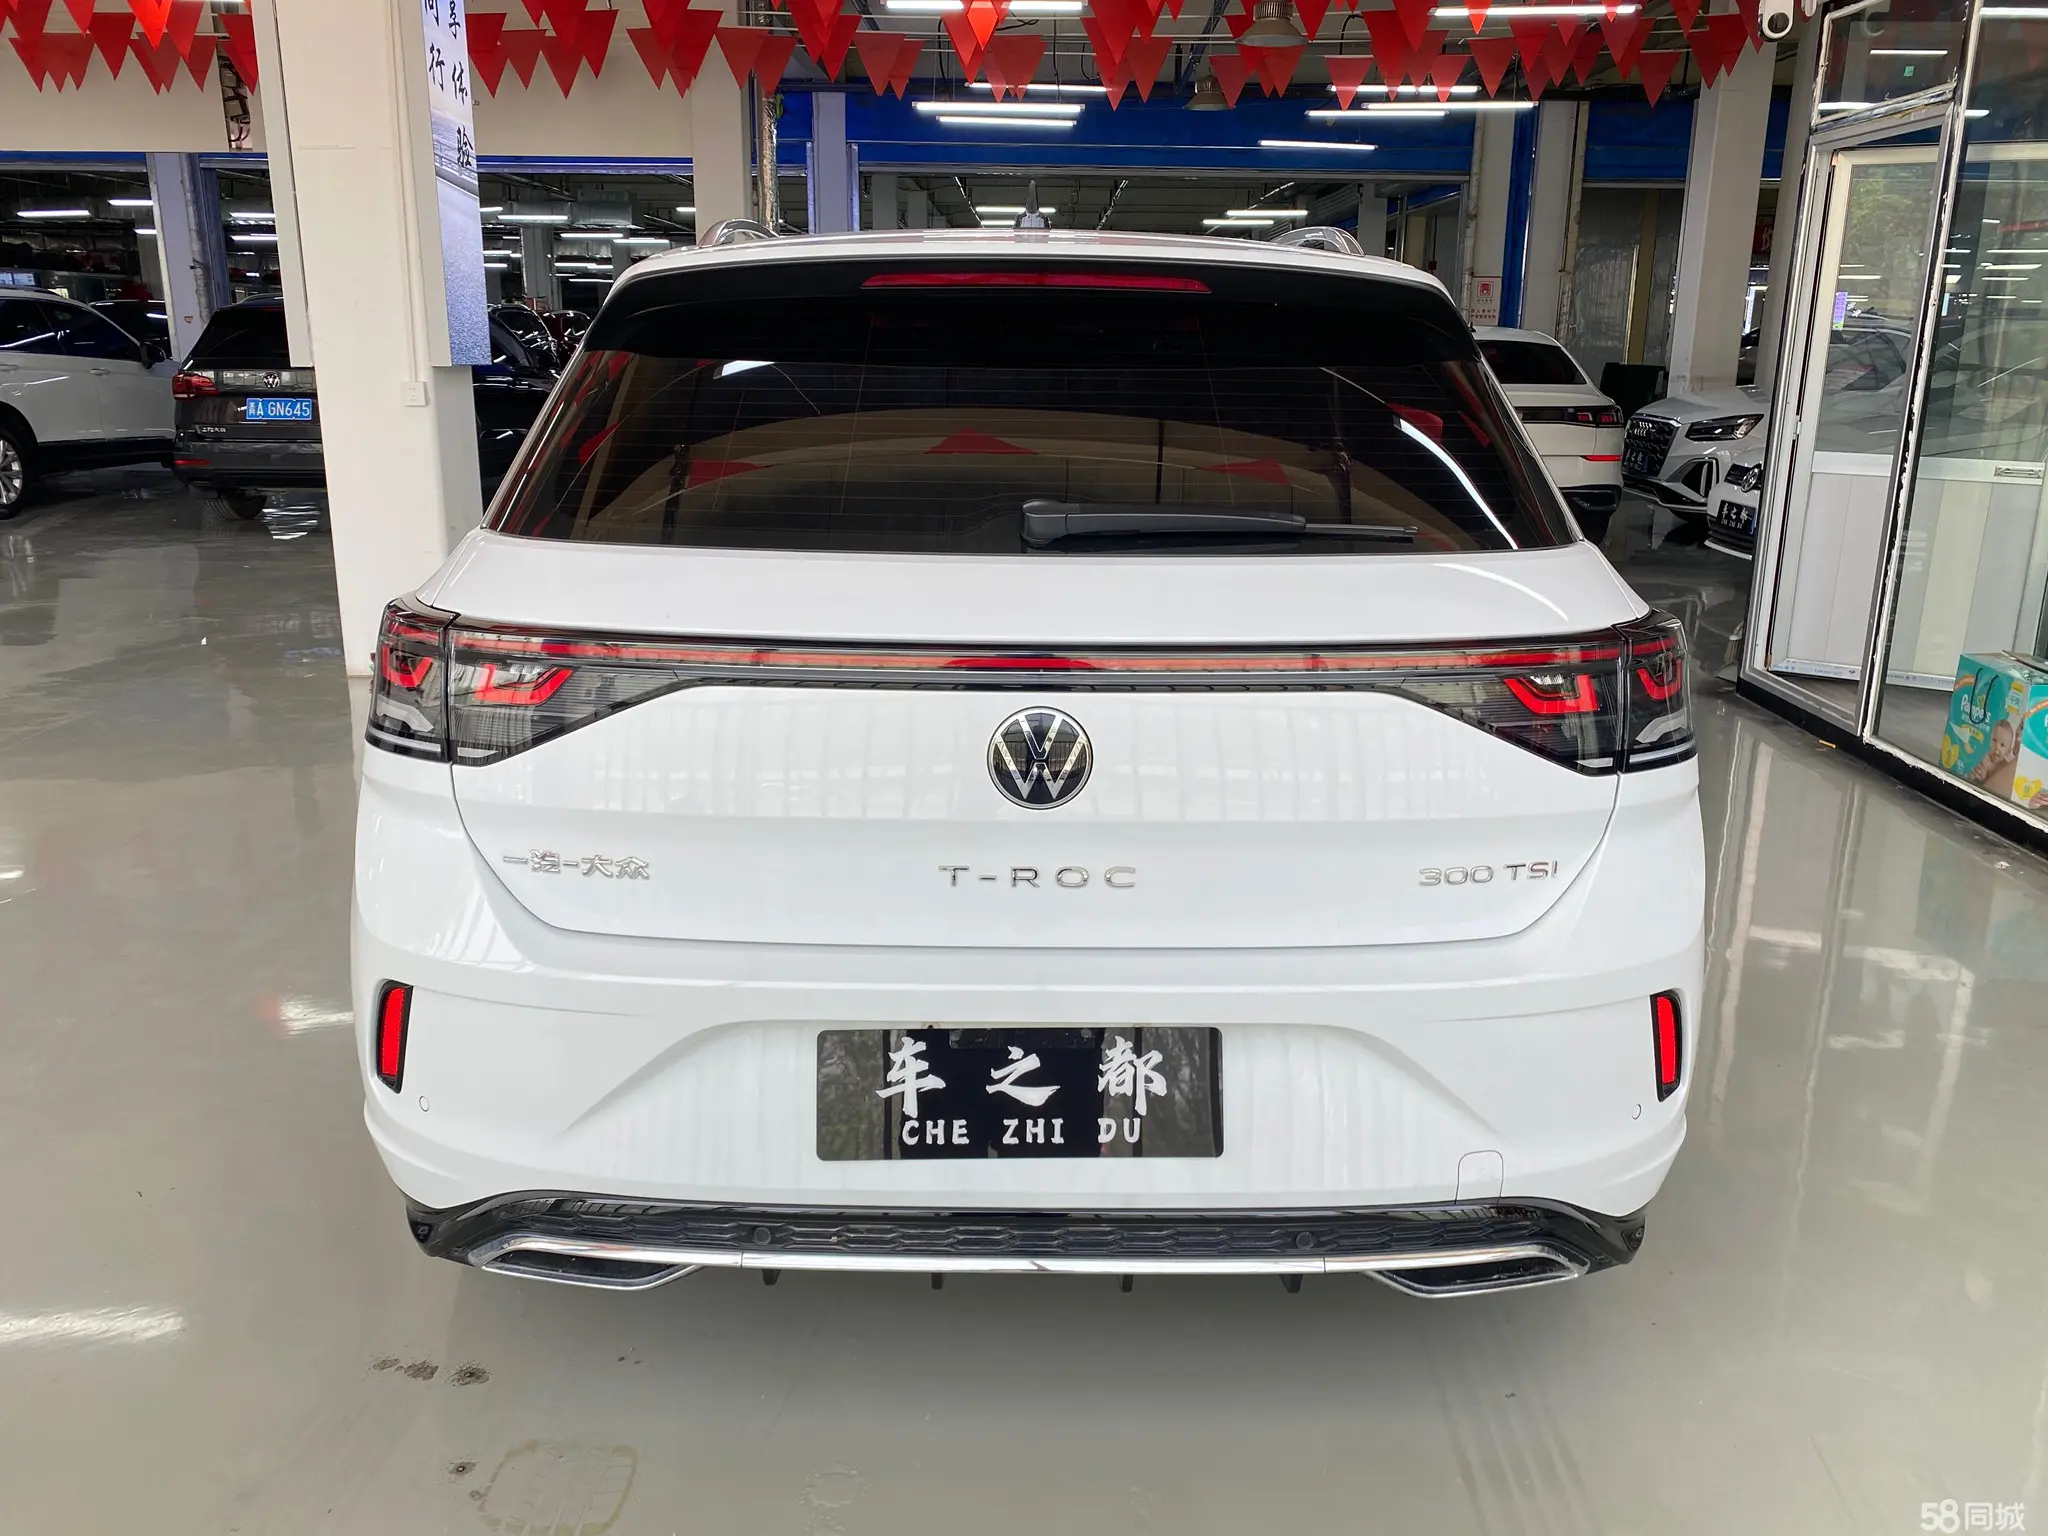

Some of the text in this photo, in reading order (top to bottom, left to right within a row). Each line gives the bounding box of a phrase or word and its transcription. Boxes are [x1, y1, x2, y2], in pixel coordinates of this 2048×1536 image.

[1961, 693, 1992, 724] Pampes
[938, 865, 1136, 888] T-ROC
[1418, 860, 1558, 887] 300 TSI
[875, 1035, 1169, 1118] 车之都
[902, 1117, 1142, 1146] CHE ZHI DU
